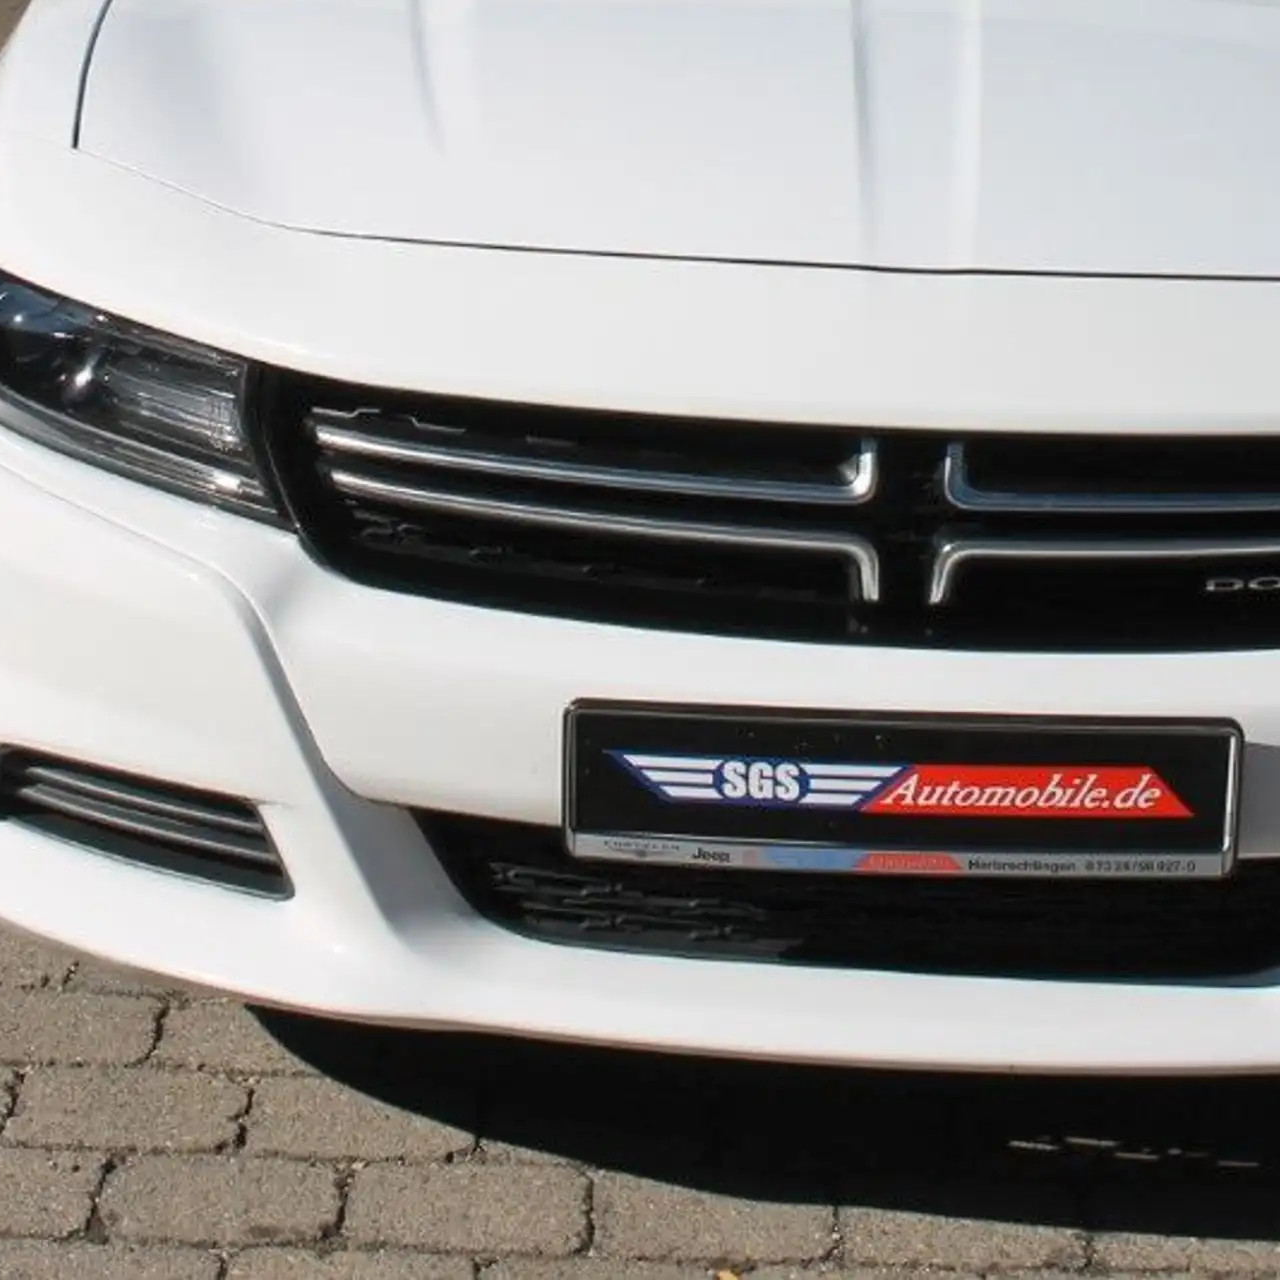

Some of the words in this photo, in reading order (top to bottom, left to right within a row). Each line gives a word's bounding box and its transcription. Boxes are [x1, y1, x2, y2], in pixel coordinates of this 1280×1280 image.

[722, 762, 800, 800] SGS
[881, 774, 1161, 810] Automobile.de
[691, 847, 731, 864] Jeep
